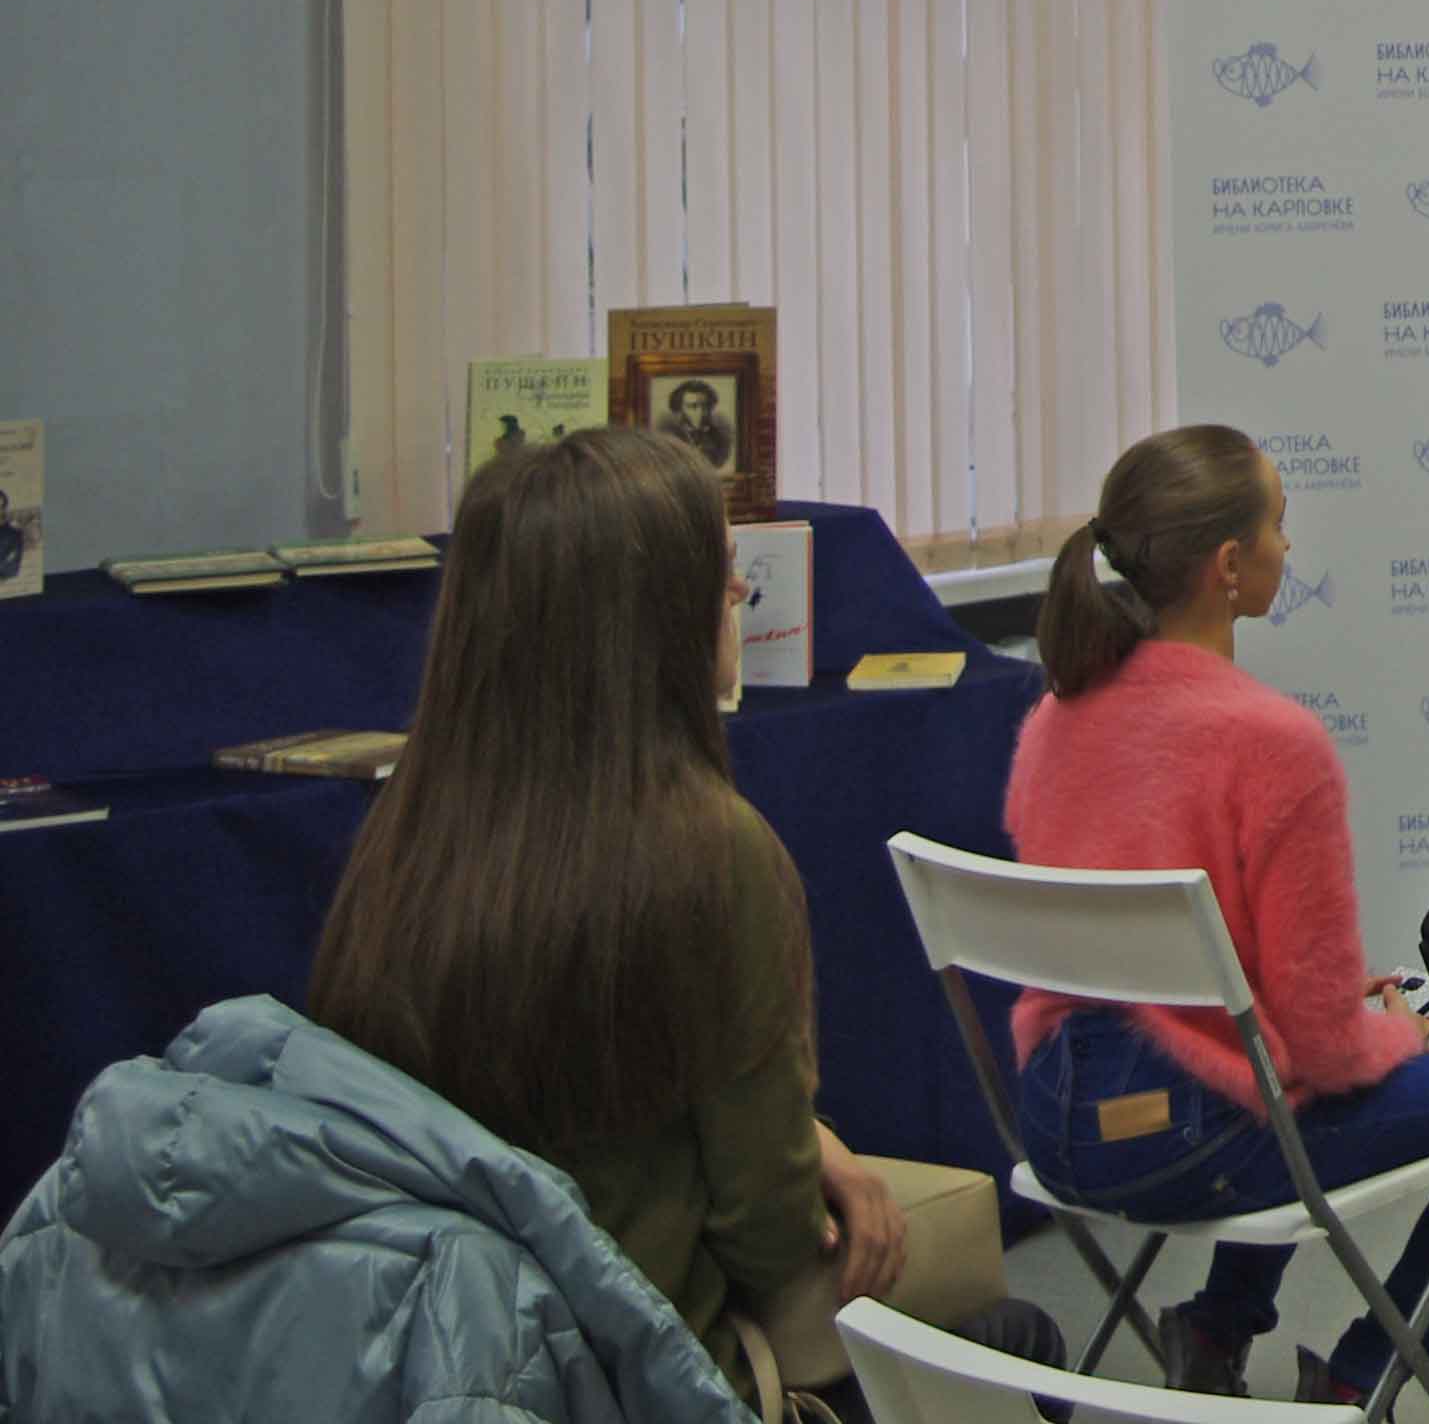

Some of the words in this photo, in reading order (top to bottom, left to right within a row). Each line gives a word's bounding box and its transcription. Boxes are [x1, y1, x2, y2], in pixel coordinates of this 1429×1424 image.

[1377, 66, 1410, 83] НА
[1212, 176, 1325, 195] БИБЛИОТЕКА
[1213, 201, 1246, 218] НА
[1253, 198, 1354, 217] КАРПОВКЕ
[630, 329, 759, 350] ПУШКИН
[1384, 325, 1416, 342] НА
[1259, 433, 1331, 454] ИОТЕКА
[1278, 456, 1360, 474] АРПОВКЕ
[1391, 582, 1424, 599] НА
